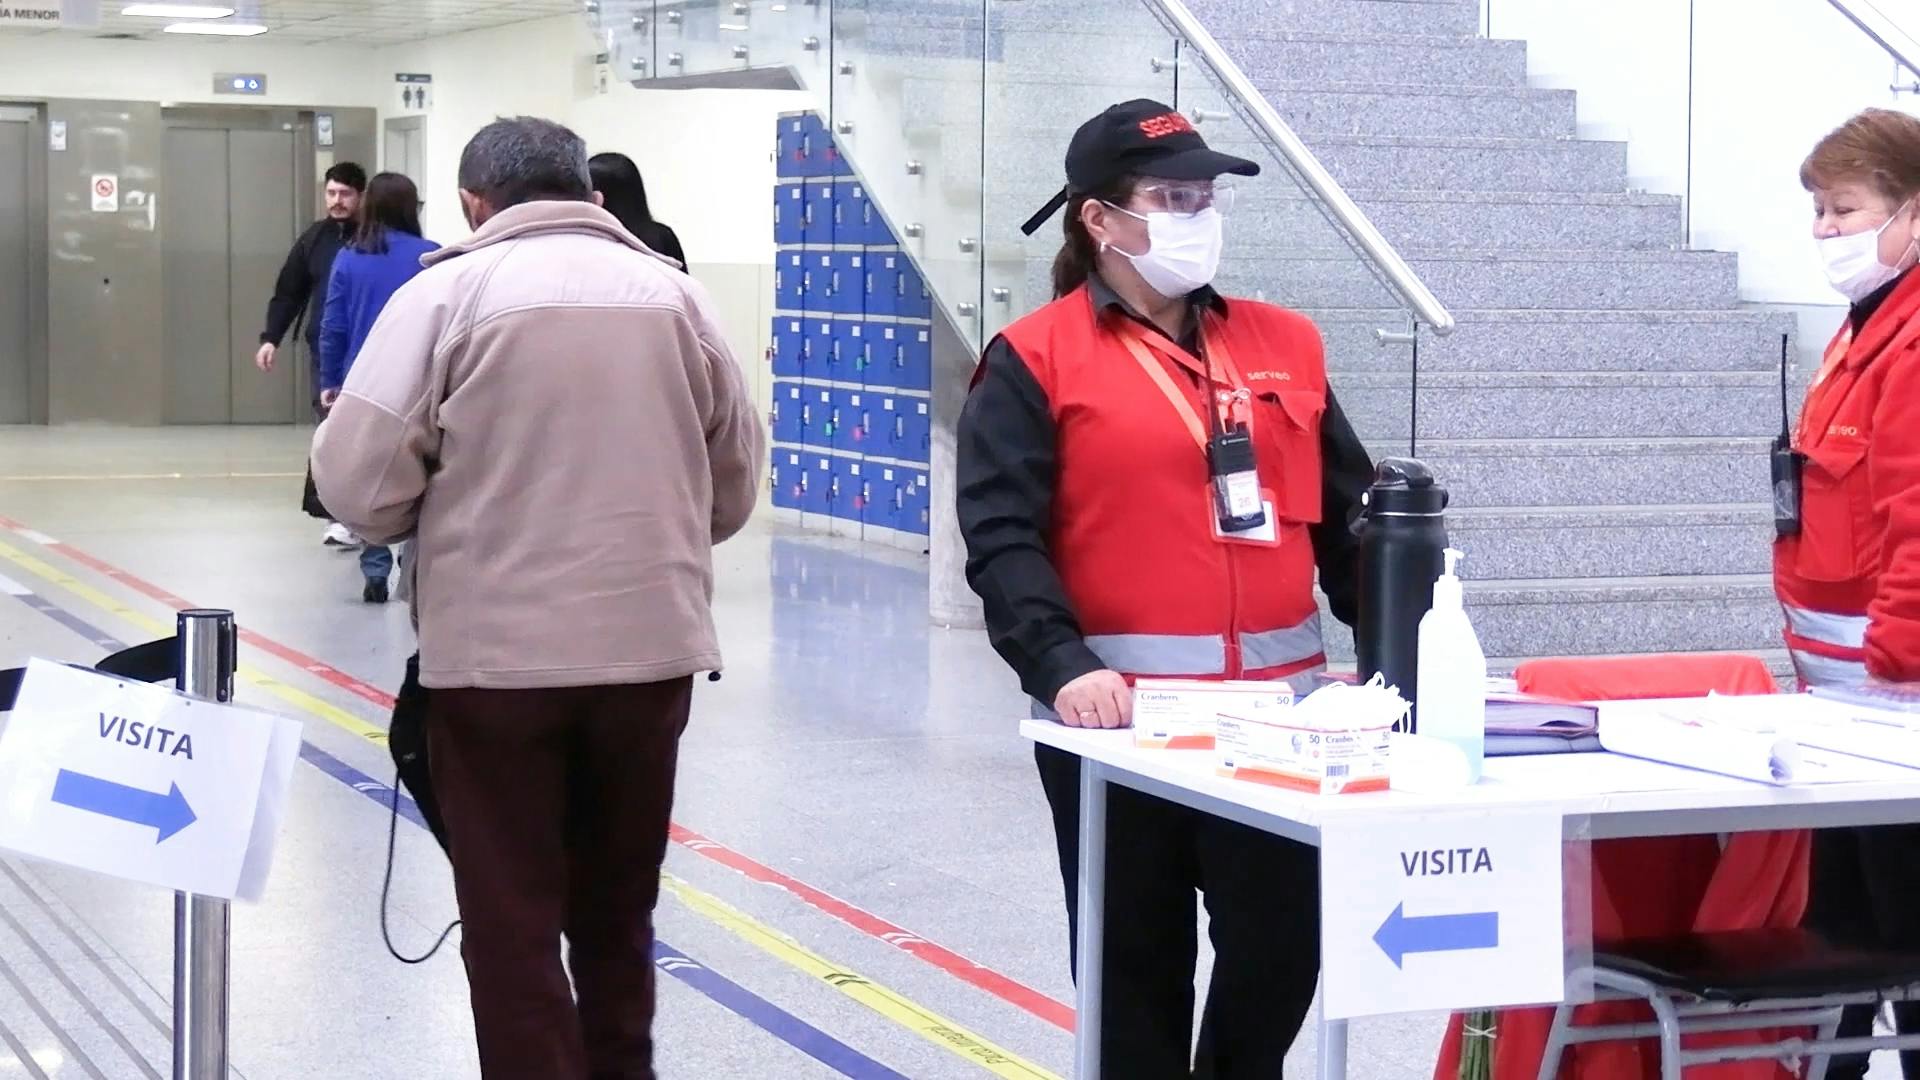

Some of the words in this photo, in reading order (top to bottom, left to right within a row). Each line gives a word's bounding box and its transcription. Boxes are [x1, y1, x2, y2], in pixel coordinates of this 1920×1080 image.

[14, 9, 60, 20] MENOR
[1141, 692, 1178, 701] Cranberry
[1277, 696, 1290, 705] 50
[99, 712, 193, 760] VISITA
[1309, 734, 1320, 744] 50
[1400, 847, 1493, 877] VISITA
